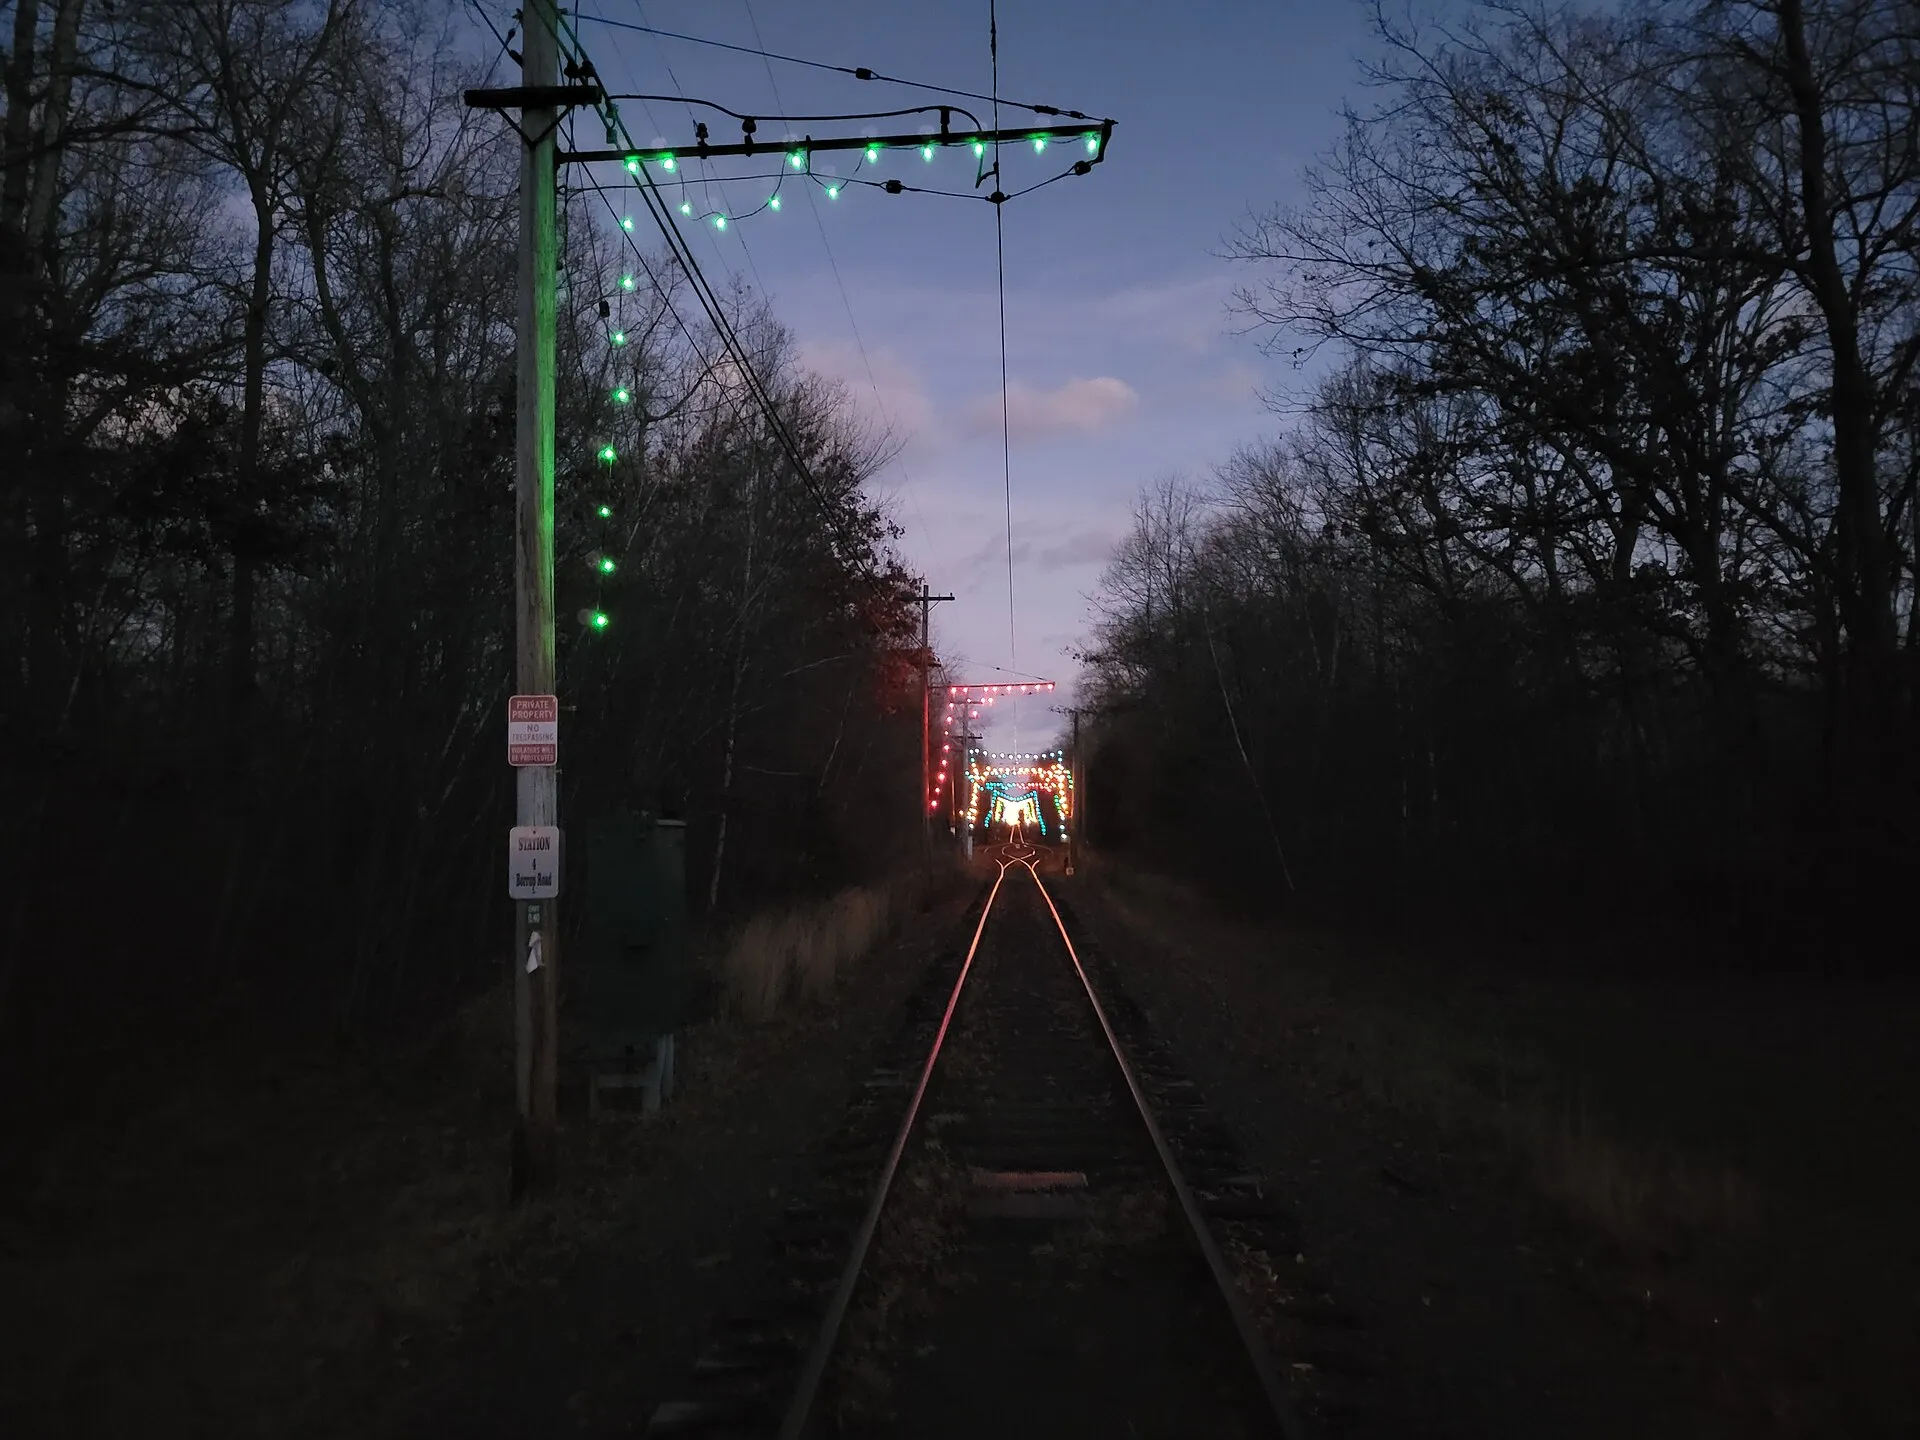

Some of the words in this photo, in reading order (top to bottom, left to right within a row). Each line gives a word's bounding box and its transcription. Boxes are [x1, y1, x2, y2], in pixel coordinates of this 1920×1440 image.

[516, 700, 549, 709] PRIVATE
[512, 710, 553, 719] PROPERTY
[527, 724, 540, 732] NO
[518, 836, 551, 851] STATION
[537, 872, 552, 886] Road
